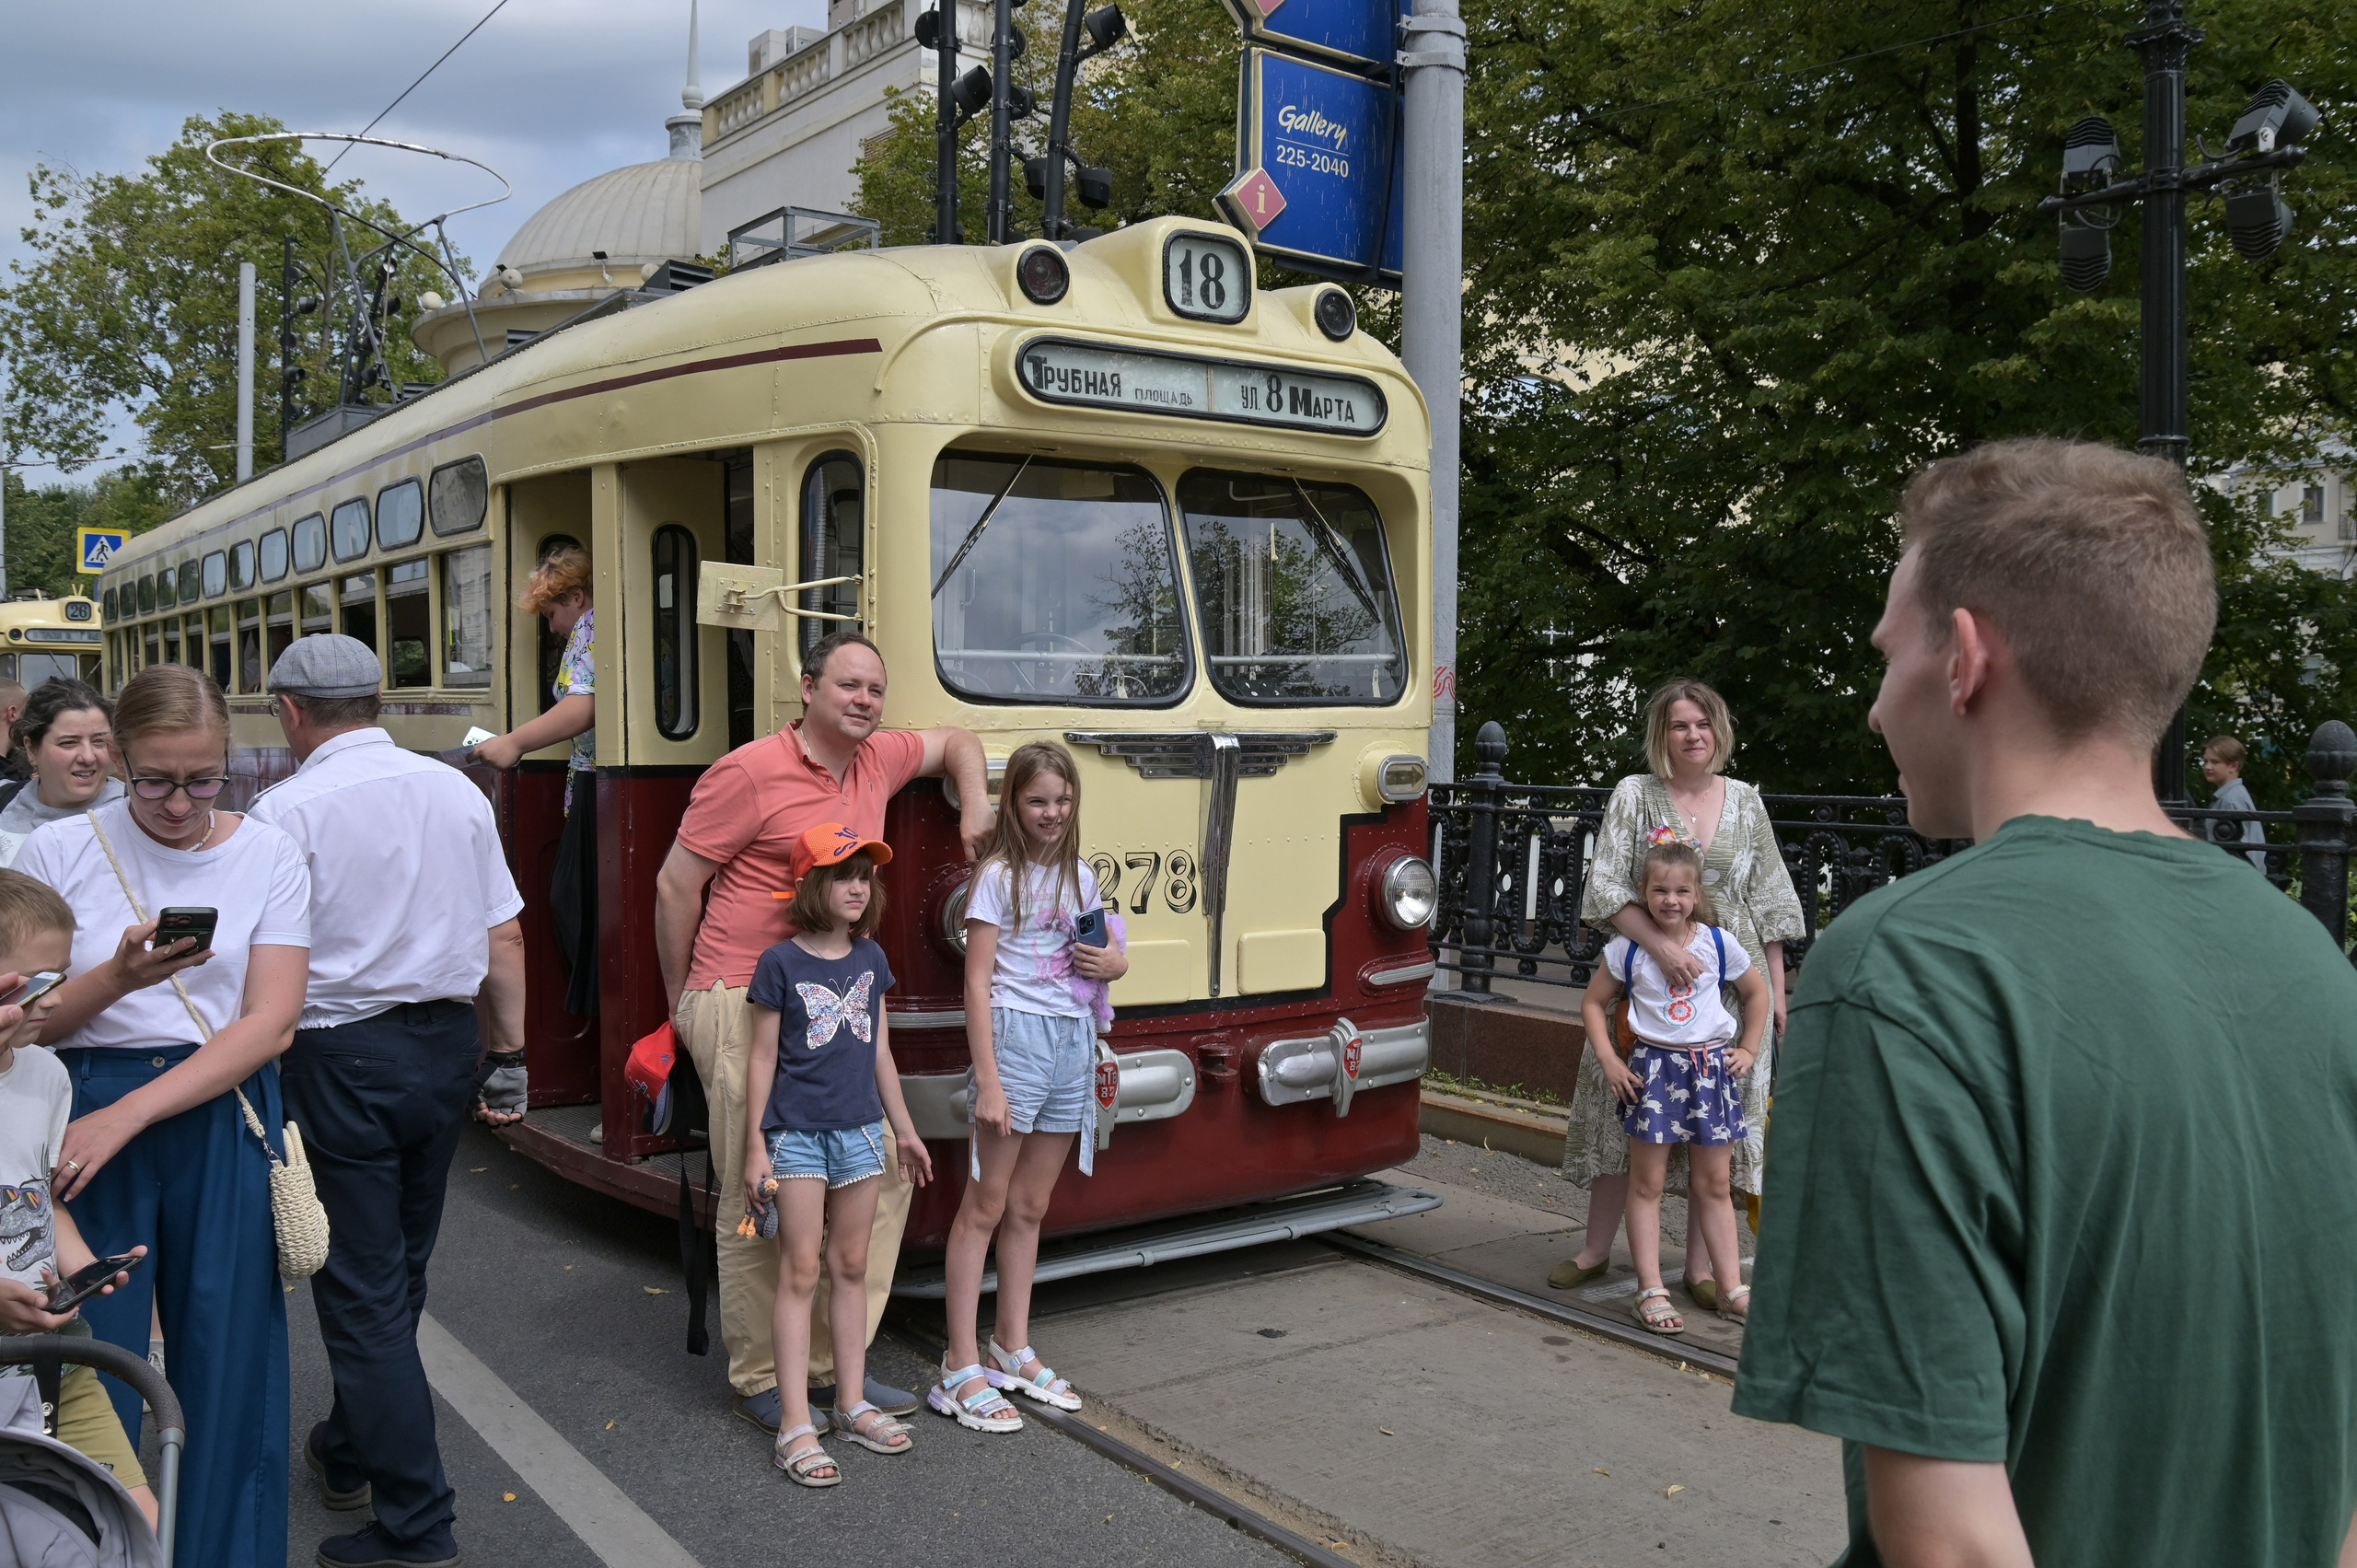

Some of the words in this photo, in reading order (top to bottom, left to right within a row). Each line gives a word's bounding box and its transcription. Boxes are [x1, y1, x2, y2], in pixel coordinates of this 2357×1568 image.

[1277, 105, 1348, 150] Gallery
[1276, 145, 1350, 179] 225-2040
[1178, 249, 1226, 310] 18
[1266, 374, 1283, 413] 8
[70, 604, 87, 618] 26
[1087, 849, 1197, 914] 278
